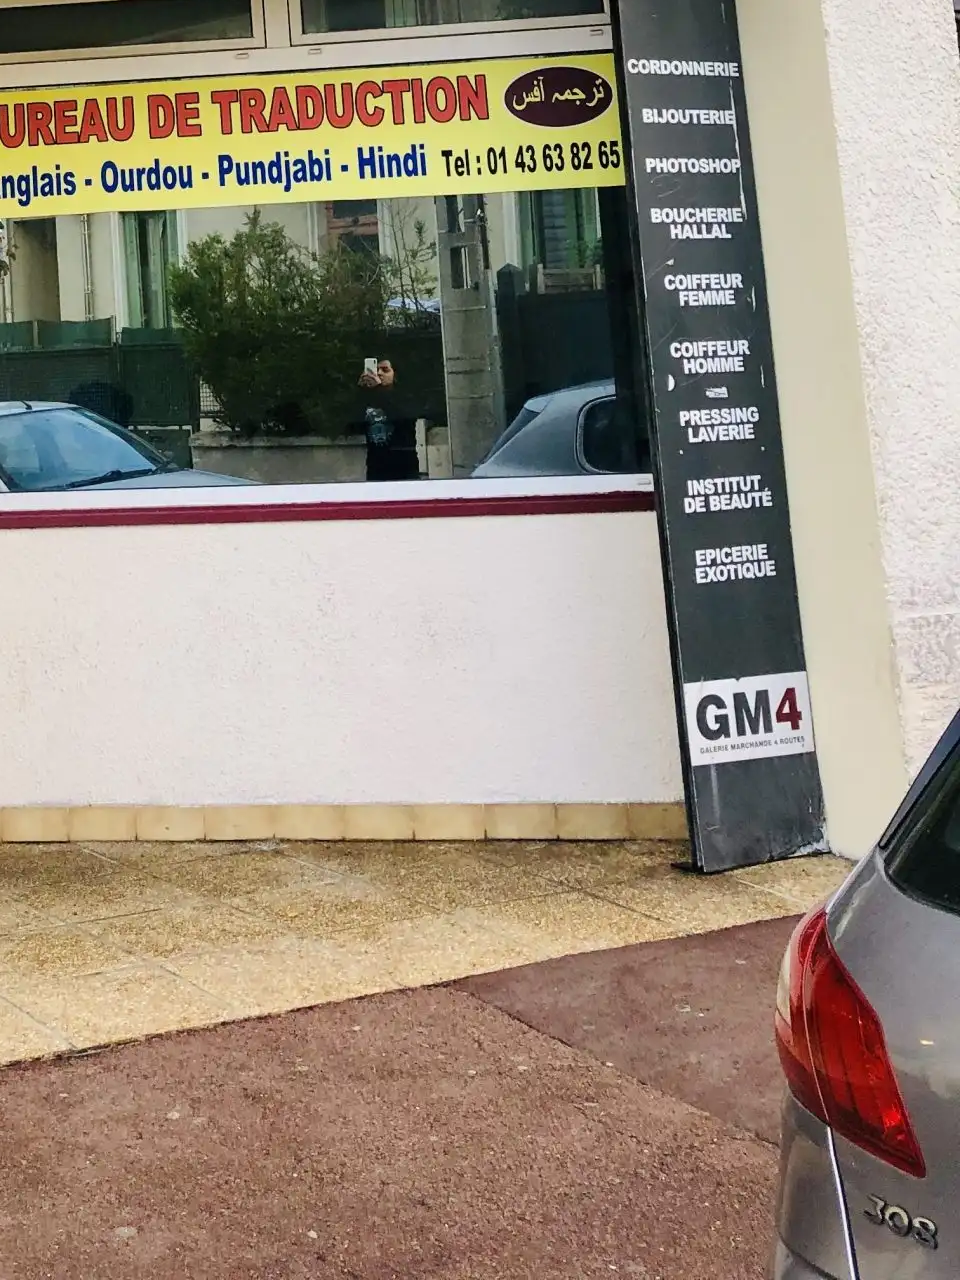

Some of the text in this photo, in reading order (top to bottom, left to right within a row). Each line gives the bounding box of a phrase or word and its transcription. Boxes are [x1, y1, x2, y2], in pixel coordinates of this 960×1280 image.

[627, 59, 739, 77] CORDONNERIE
[147, 92, 202, 139] DE
[211, 74, 490, 135] TRADUCTION
[642, 108, 735, 125] BIJOUTERIE
[100, 158, 193, 194] Ourdou
[218, 149, 332, 192] Pundjabi
[357, 144, 427, 180] Hindi
[487, 147, 507, 174] 01
[515, 145, 537, 173] 43
[542, 143, 564, 172] 63
[571, 141, 593, 170] 82
[598, 140, 621, 169] 65
[645, 158, 740, 174] PHOTOSHOP
[650, 207, 743, 223] BOUCHERIE
[670, 224, 732, 239] HALLAL
[664, 273, 743, 290] COIFFEUR
[679, 290, 736, 306] FEMME
[670, 340, 750, 358] COIFFEUR
[683, 357, 745, 375] HOMME
[679, 407, 760, 426] PRESSING
[688, 424, 755, 443] LAVERIE
[687, 475, 761, 496] INSTITUT
[683, 488, 773, 514] DE BEAUTÉ
[695, 544, 768, 566] EPICERIE
[695, 560, 777, 584] EXOTIQUE
[696, 687, 802, 741] GM4
[700, 744, 729, 754] GALERIE
[730, 739, 772, 751] MARCHANDE
[780, 735, 805, 745] ROUTES
[863, 1193, 938, 1250] 308
